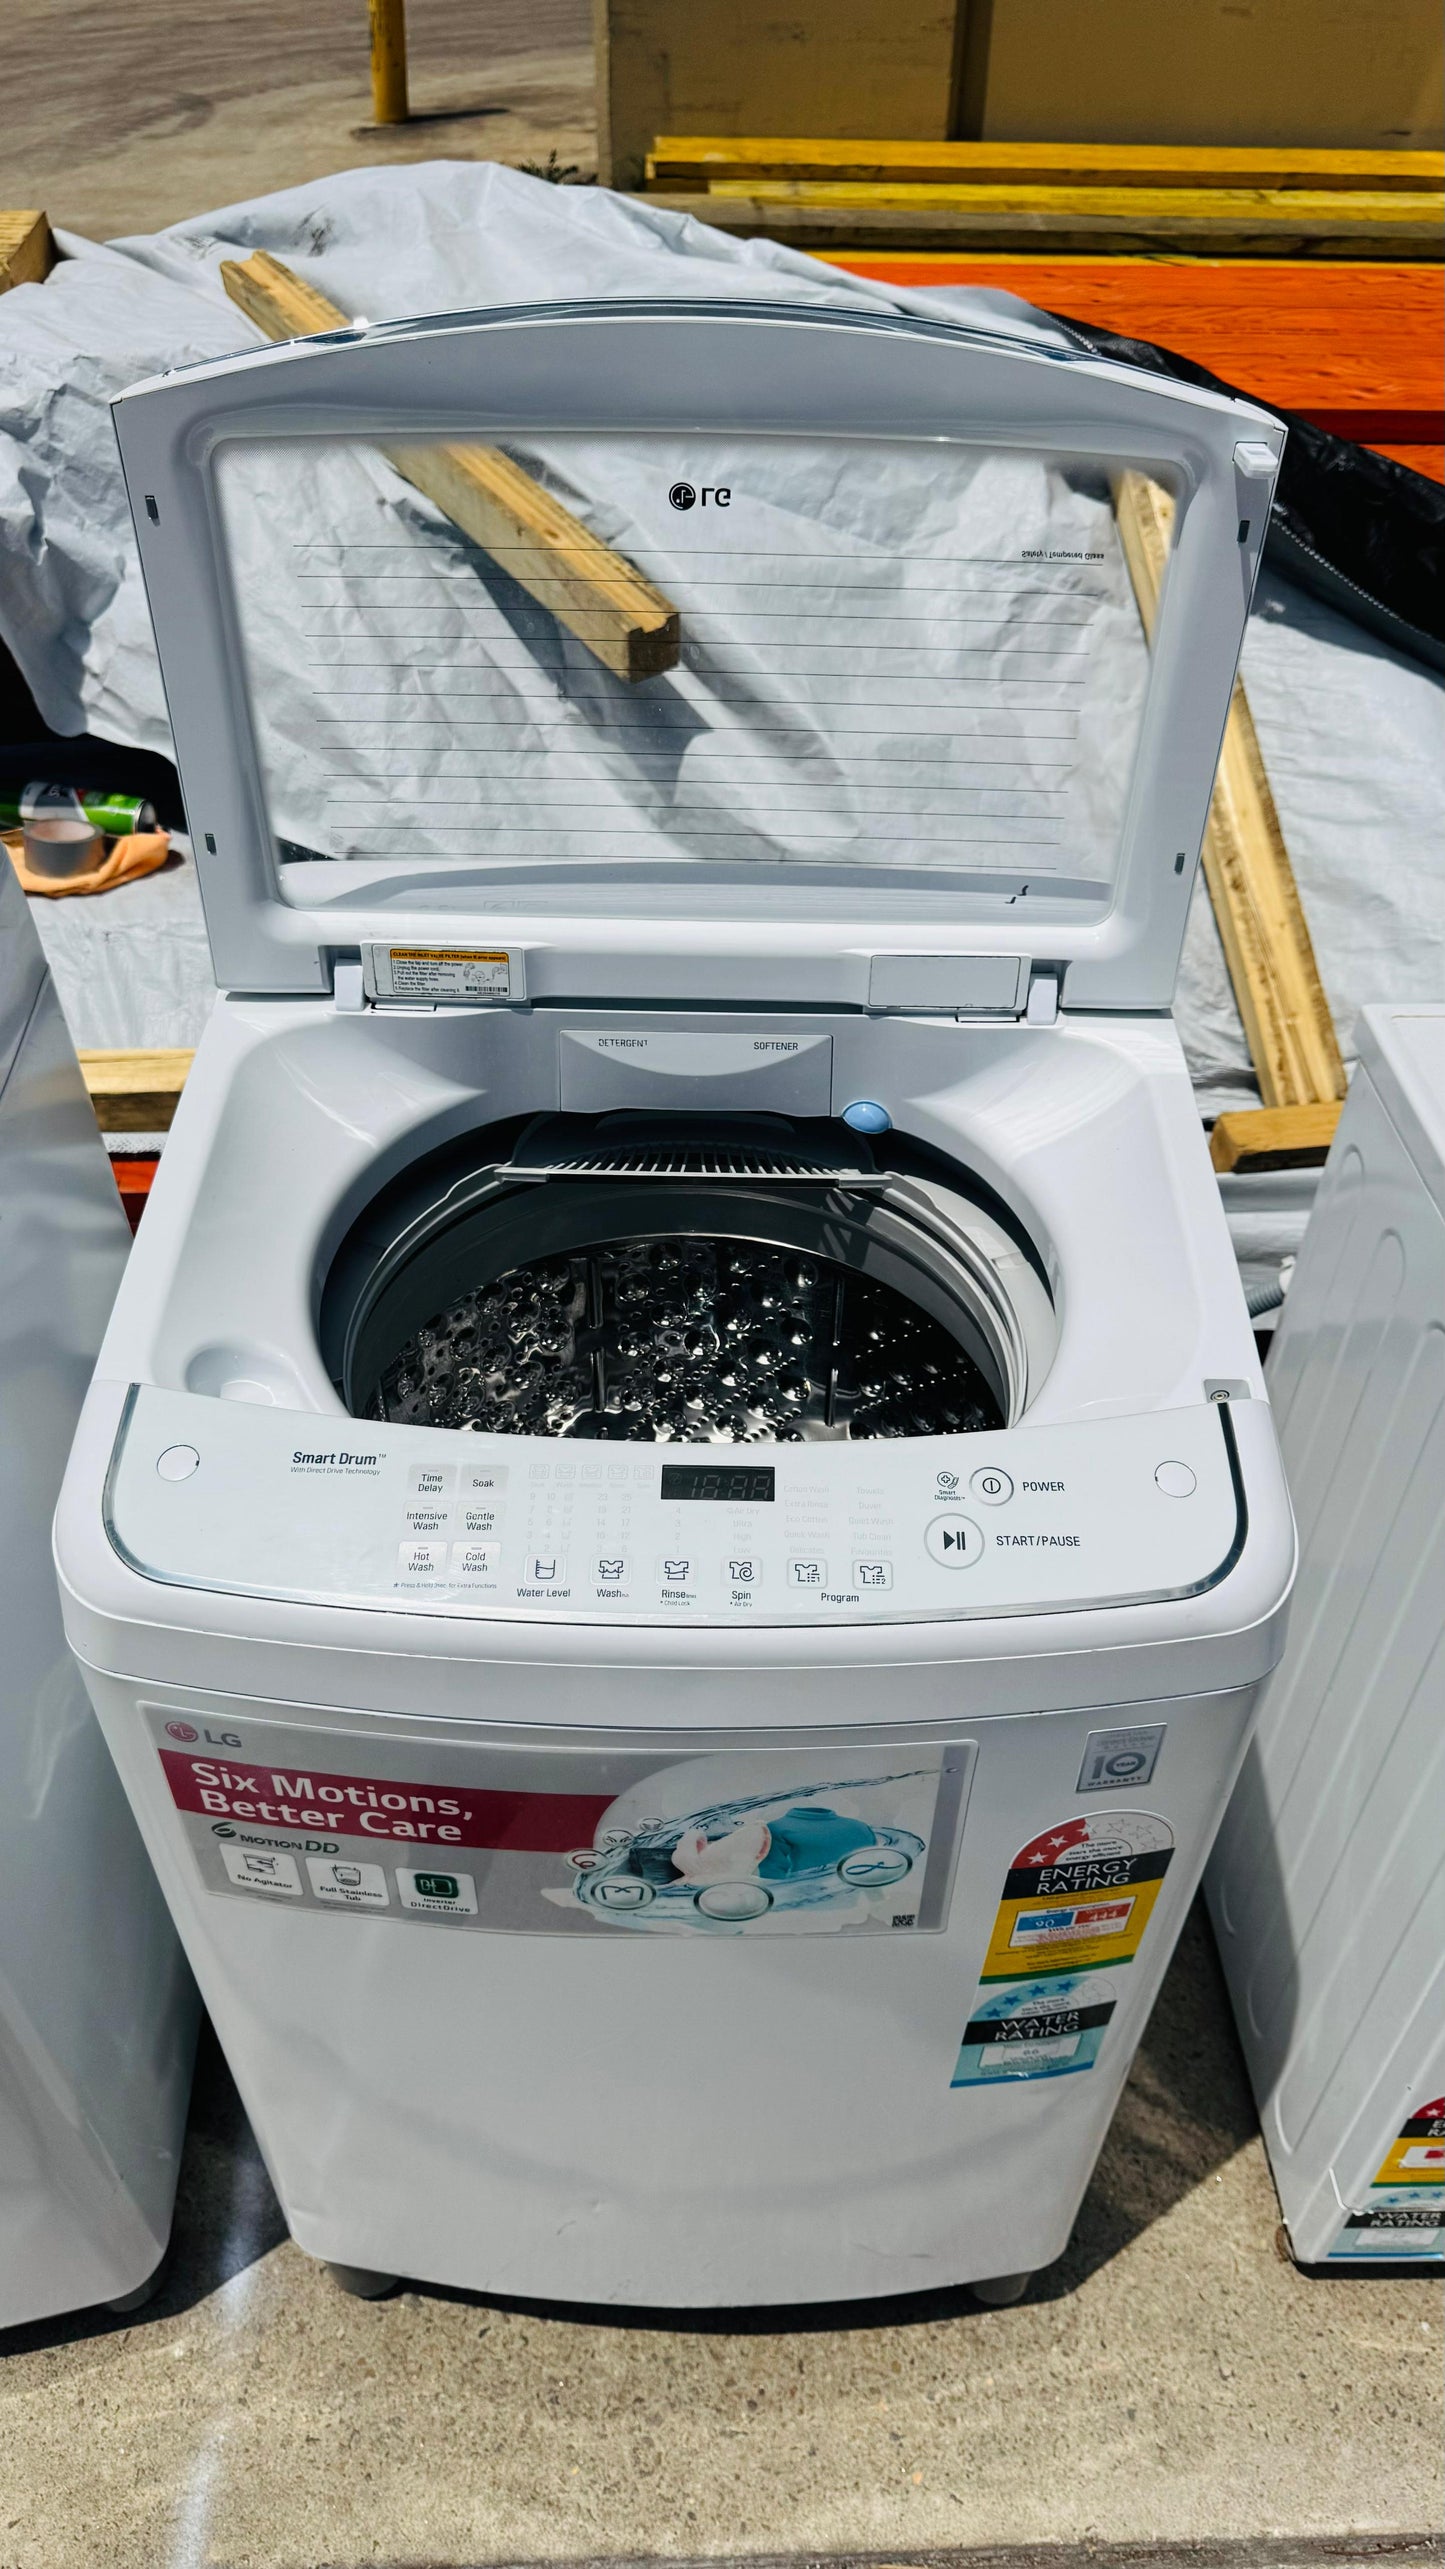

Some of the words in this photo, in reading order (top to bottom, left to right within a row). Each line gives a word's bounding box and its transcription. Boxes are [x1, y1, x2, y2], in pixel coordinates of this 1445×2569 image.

[598, 1038, 648, 1048] DETERGENT
[753, 1041, 799, 1051] SOFTENER
[292, 1451, 336, 1465] Smart
[345, 1468, 381, 1476] Technology
[421, 1473, 443, 1483] Time
[418, 1483, 444, 1494] Delay
[472, 1479, 495, 1488] Soak
[1022, 1481, 1065, 1492] POWER
[406, 1511, 448, 1521] Intensive
[465, 1511, 495, 1521] Gentle
[413, 1521, 439, 1531] Wash
[466, 1522, 493, 1531] Wash
[996, 1535, 1081, 1547] START/PAUSE
[413, 1552, 430, 1561] Hot
[465, 1552, 486, 1561] Cold
[408, 1562, 435, 1572] Wash
[461, 1562, 488, 1572] Wash
[516, 1588, 545, 1598] Water
[546, 1588, 571, 1598] Level
[596, 1588, 622, 1598] Wash
[661, 1589, 686, 1598] Rinse
[731, 1590, 752, 1601] Spin
[820, 1592, 860, 1604] Program
[204, 1729, 242, 1748] LG
[1087, 1776, 1144, 1787] WARRANTY
[190, 1761, 260, 1794] Six
[270, 1773, 473, 1821] Motions,
[199, 1788, 344, 1829] Better
[359, 1811, 462, 1842] Care
[1039, 1857, 1138, 1881] ENERGY
[237, 1874, 252, 1882] No
[253, 1877, 293, 1889] Agitator
[1036, 1872, 1131, 1895] RATING
[319, 1885, 337, 1893] Full
[339, 1888, 383, 1898] Stainless
[344, 1894, 361, 1902] Tub
[1001, 2011, 1080, 2031] WATER
[994, 2023, 1079, 2041] RATING
[1378, 2212, 1442, 2220] WATER
[1370, 2219, 1440, 2227] RATING
